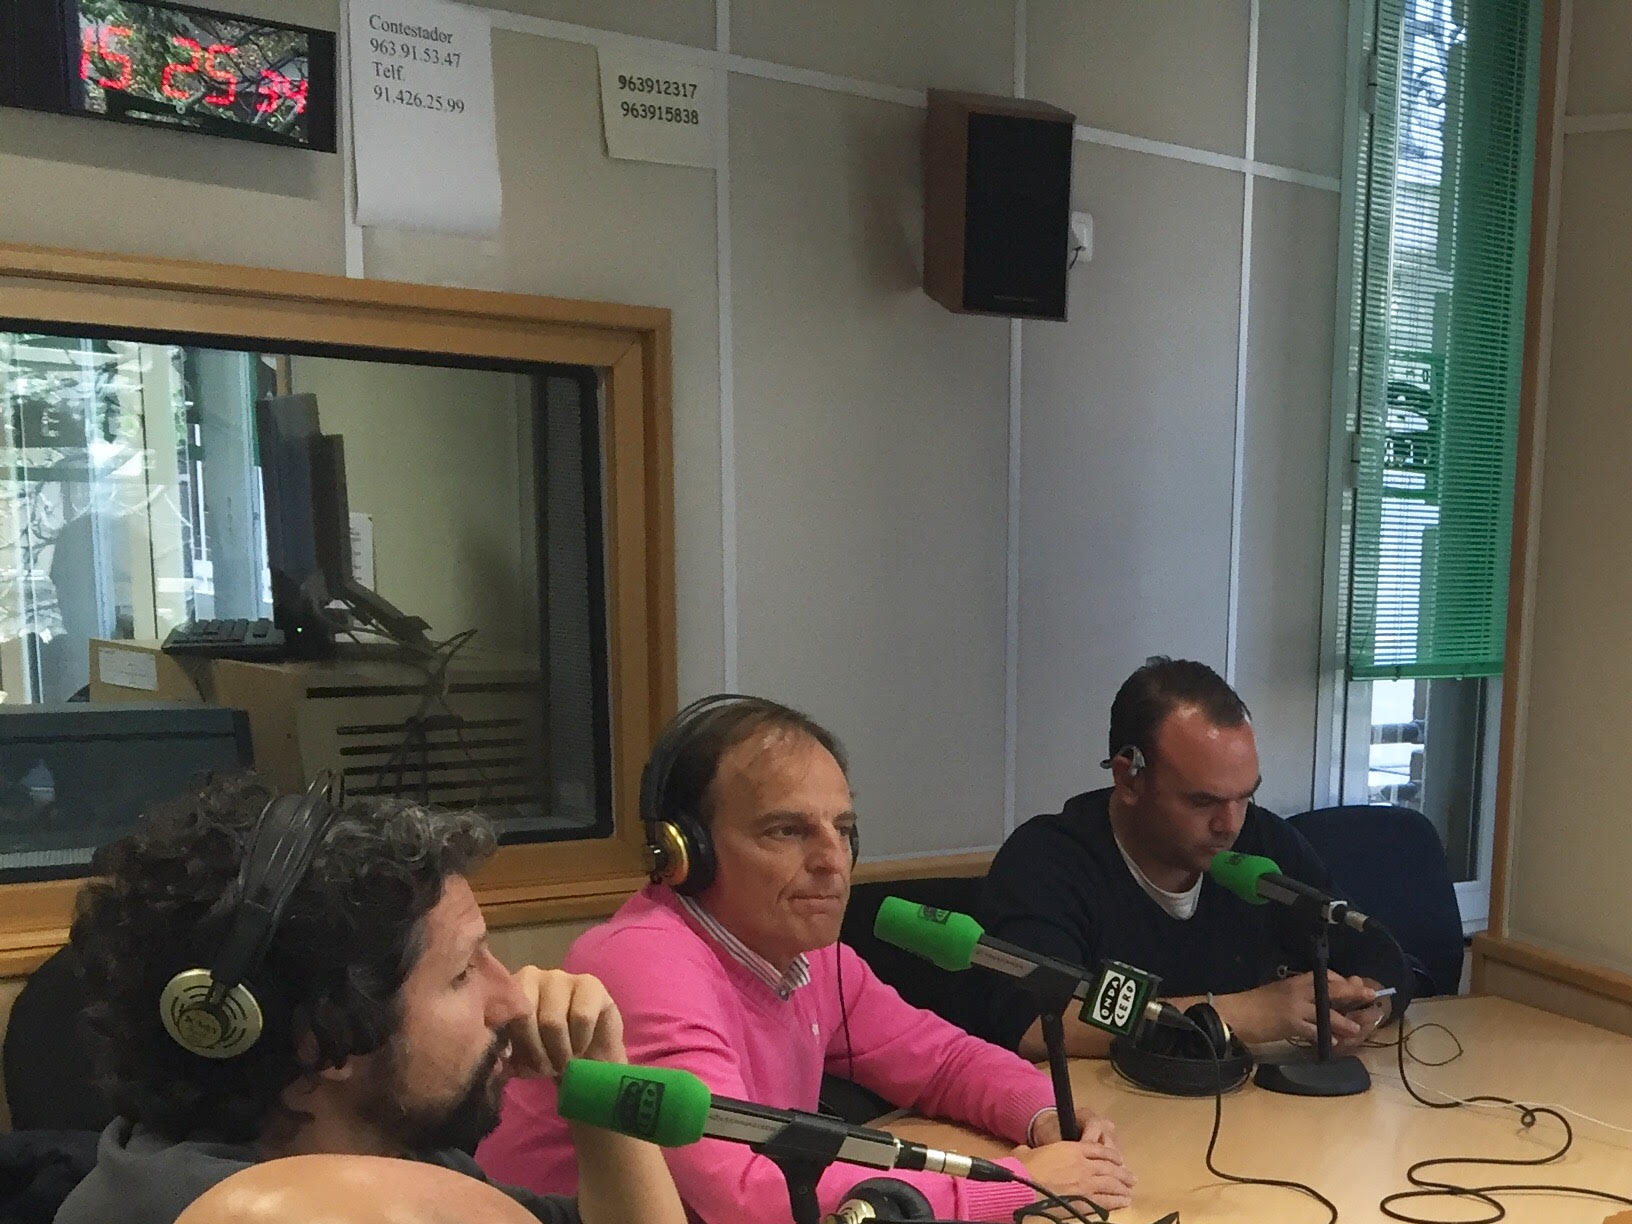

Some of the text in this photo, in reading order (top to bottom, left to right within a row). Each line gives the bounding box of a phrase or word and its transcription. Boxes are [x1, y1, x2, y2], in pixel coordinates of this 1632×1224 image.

[369, 14, 453, 44] Contestador
[79, 25, 132, 90] 15
[160, 36, 238, 106] 25
[618, 75, 697, 99] 963912317
[621, 101, 699, 125] 963915838
[1101, 980, 1119, 1018] ONDA
[1116, 985, 1134, 1020] CERO
